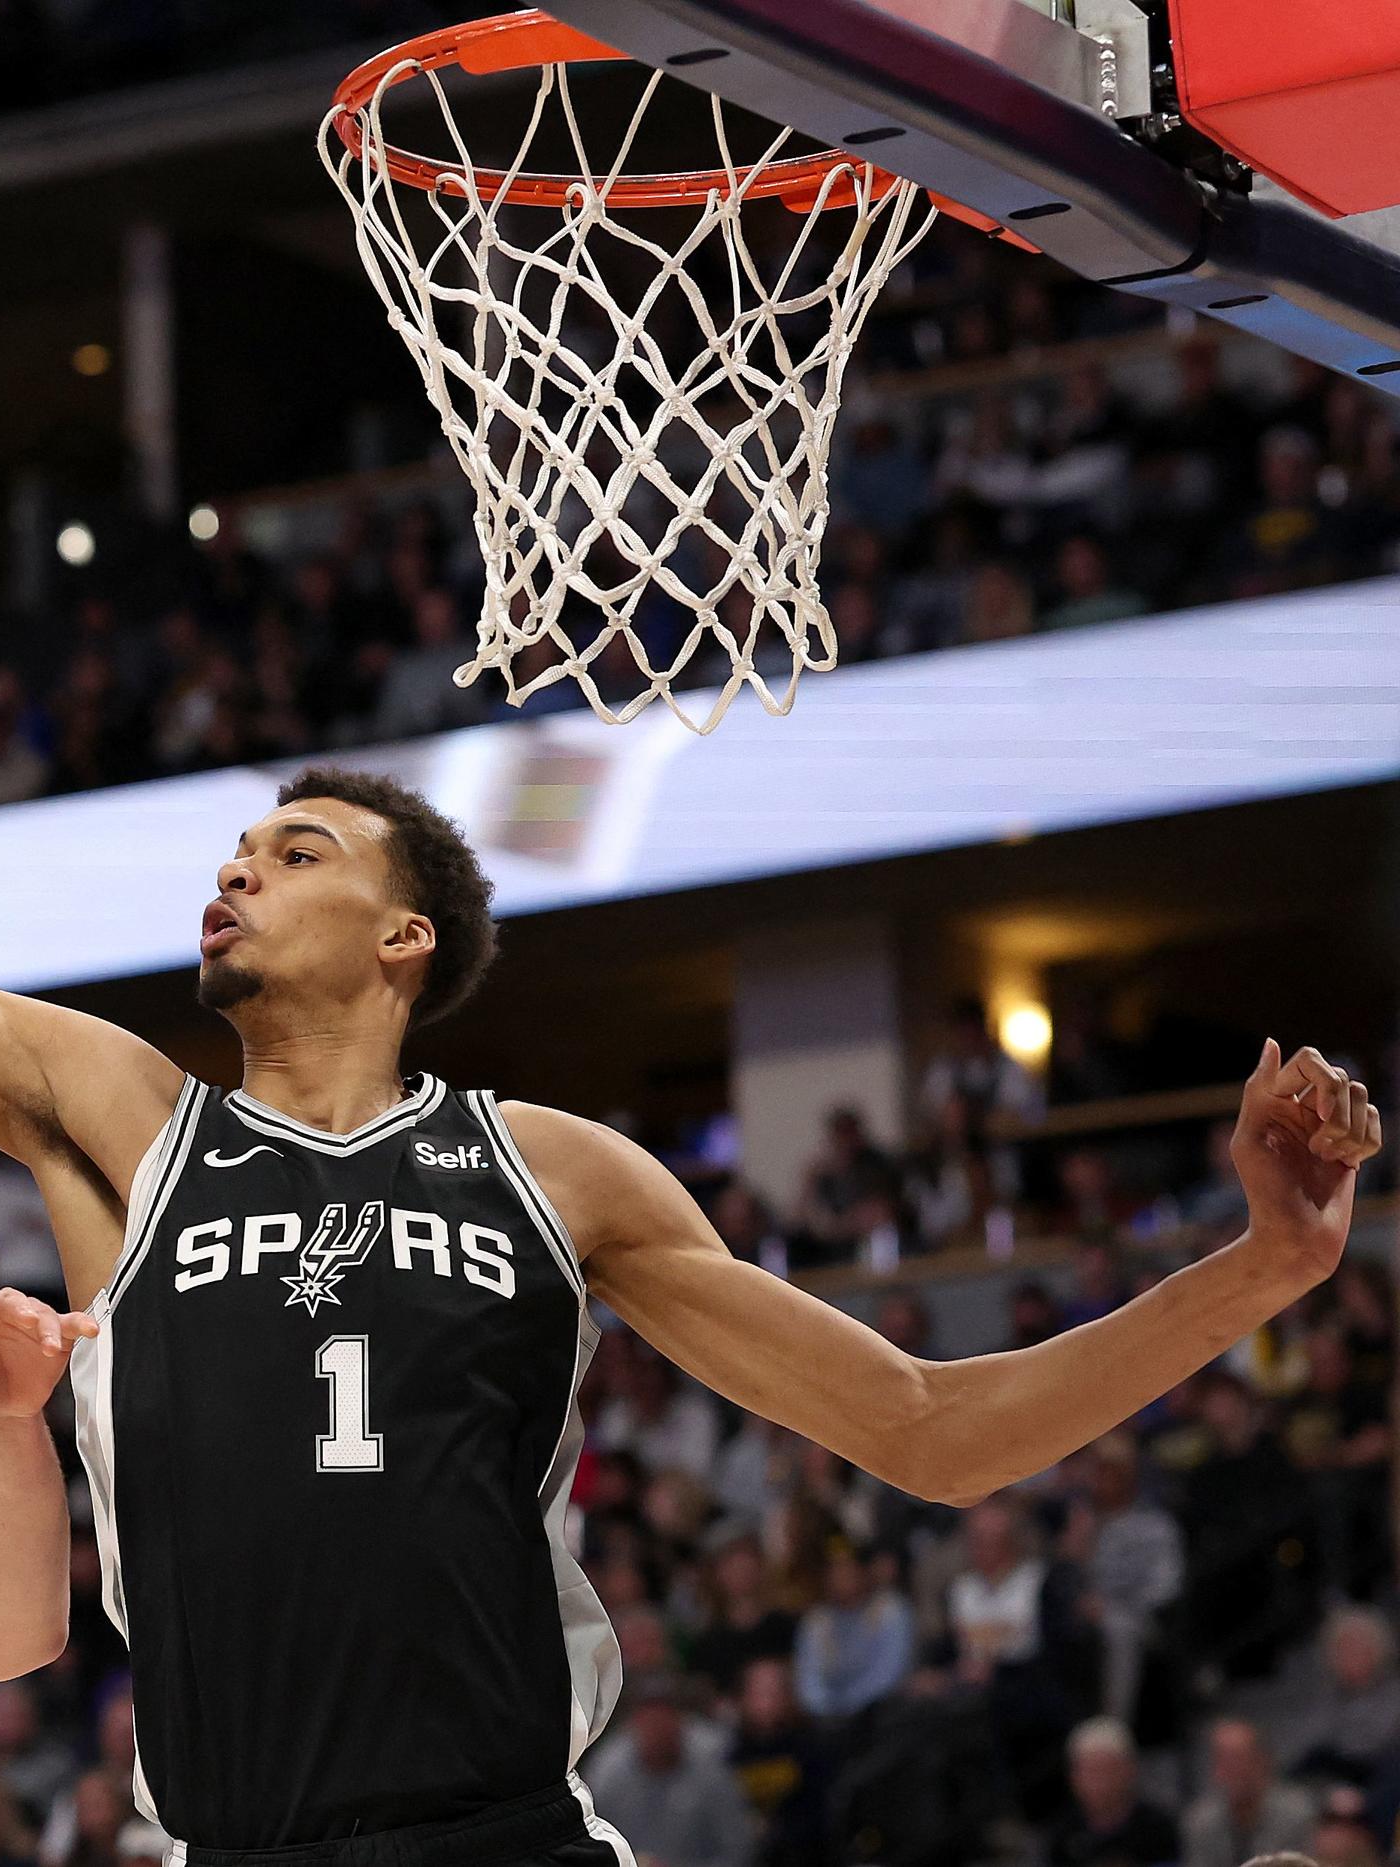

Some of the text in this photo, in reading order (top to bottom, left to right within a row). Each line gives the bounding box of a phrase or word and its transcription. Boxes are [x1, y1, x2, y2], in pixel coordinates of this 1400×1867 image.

[414, 1141, 490, 1169] Self.
[174, 1200, 516, 1318] SPURS
[315, 1334, 384, 1472] 1
